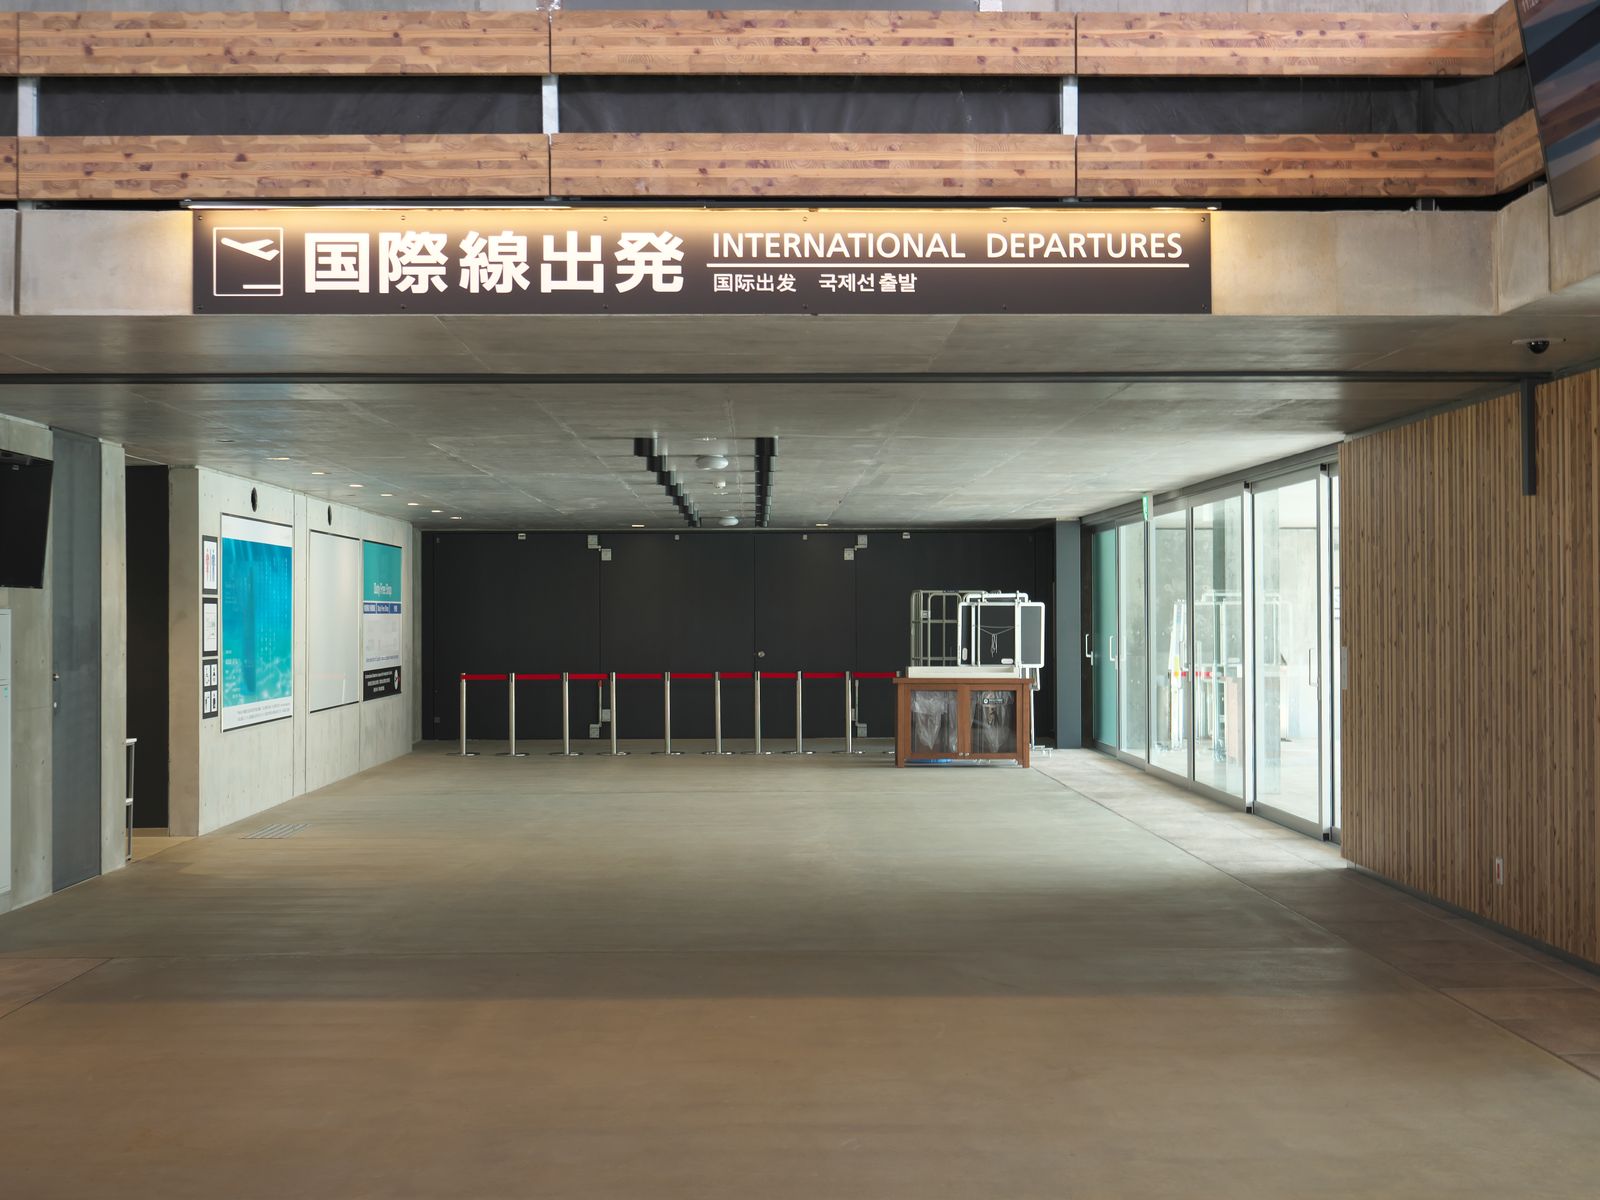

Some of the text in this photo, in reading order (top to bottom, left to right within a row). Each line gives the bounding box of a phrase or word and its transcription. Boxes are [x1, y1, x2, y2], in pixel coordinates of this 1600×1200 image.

[713, 232, 1183, 258] INTERNATIONAL DEPARTURES
[304, 230, 685, 294] 国際線出発
[713, 273, 797, 292] 国际出发
[818, 273, 918, 292] 국제선 출발
